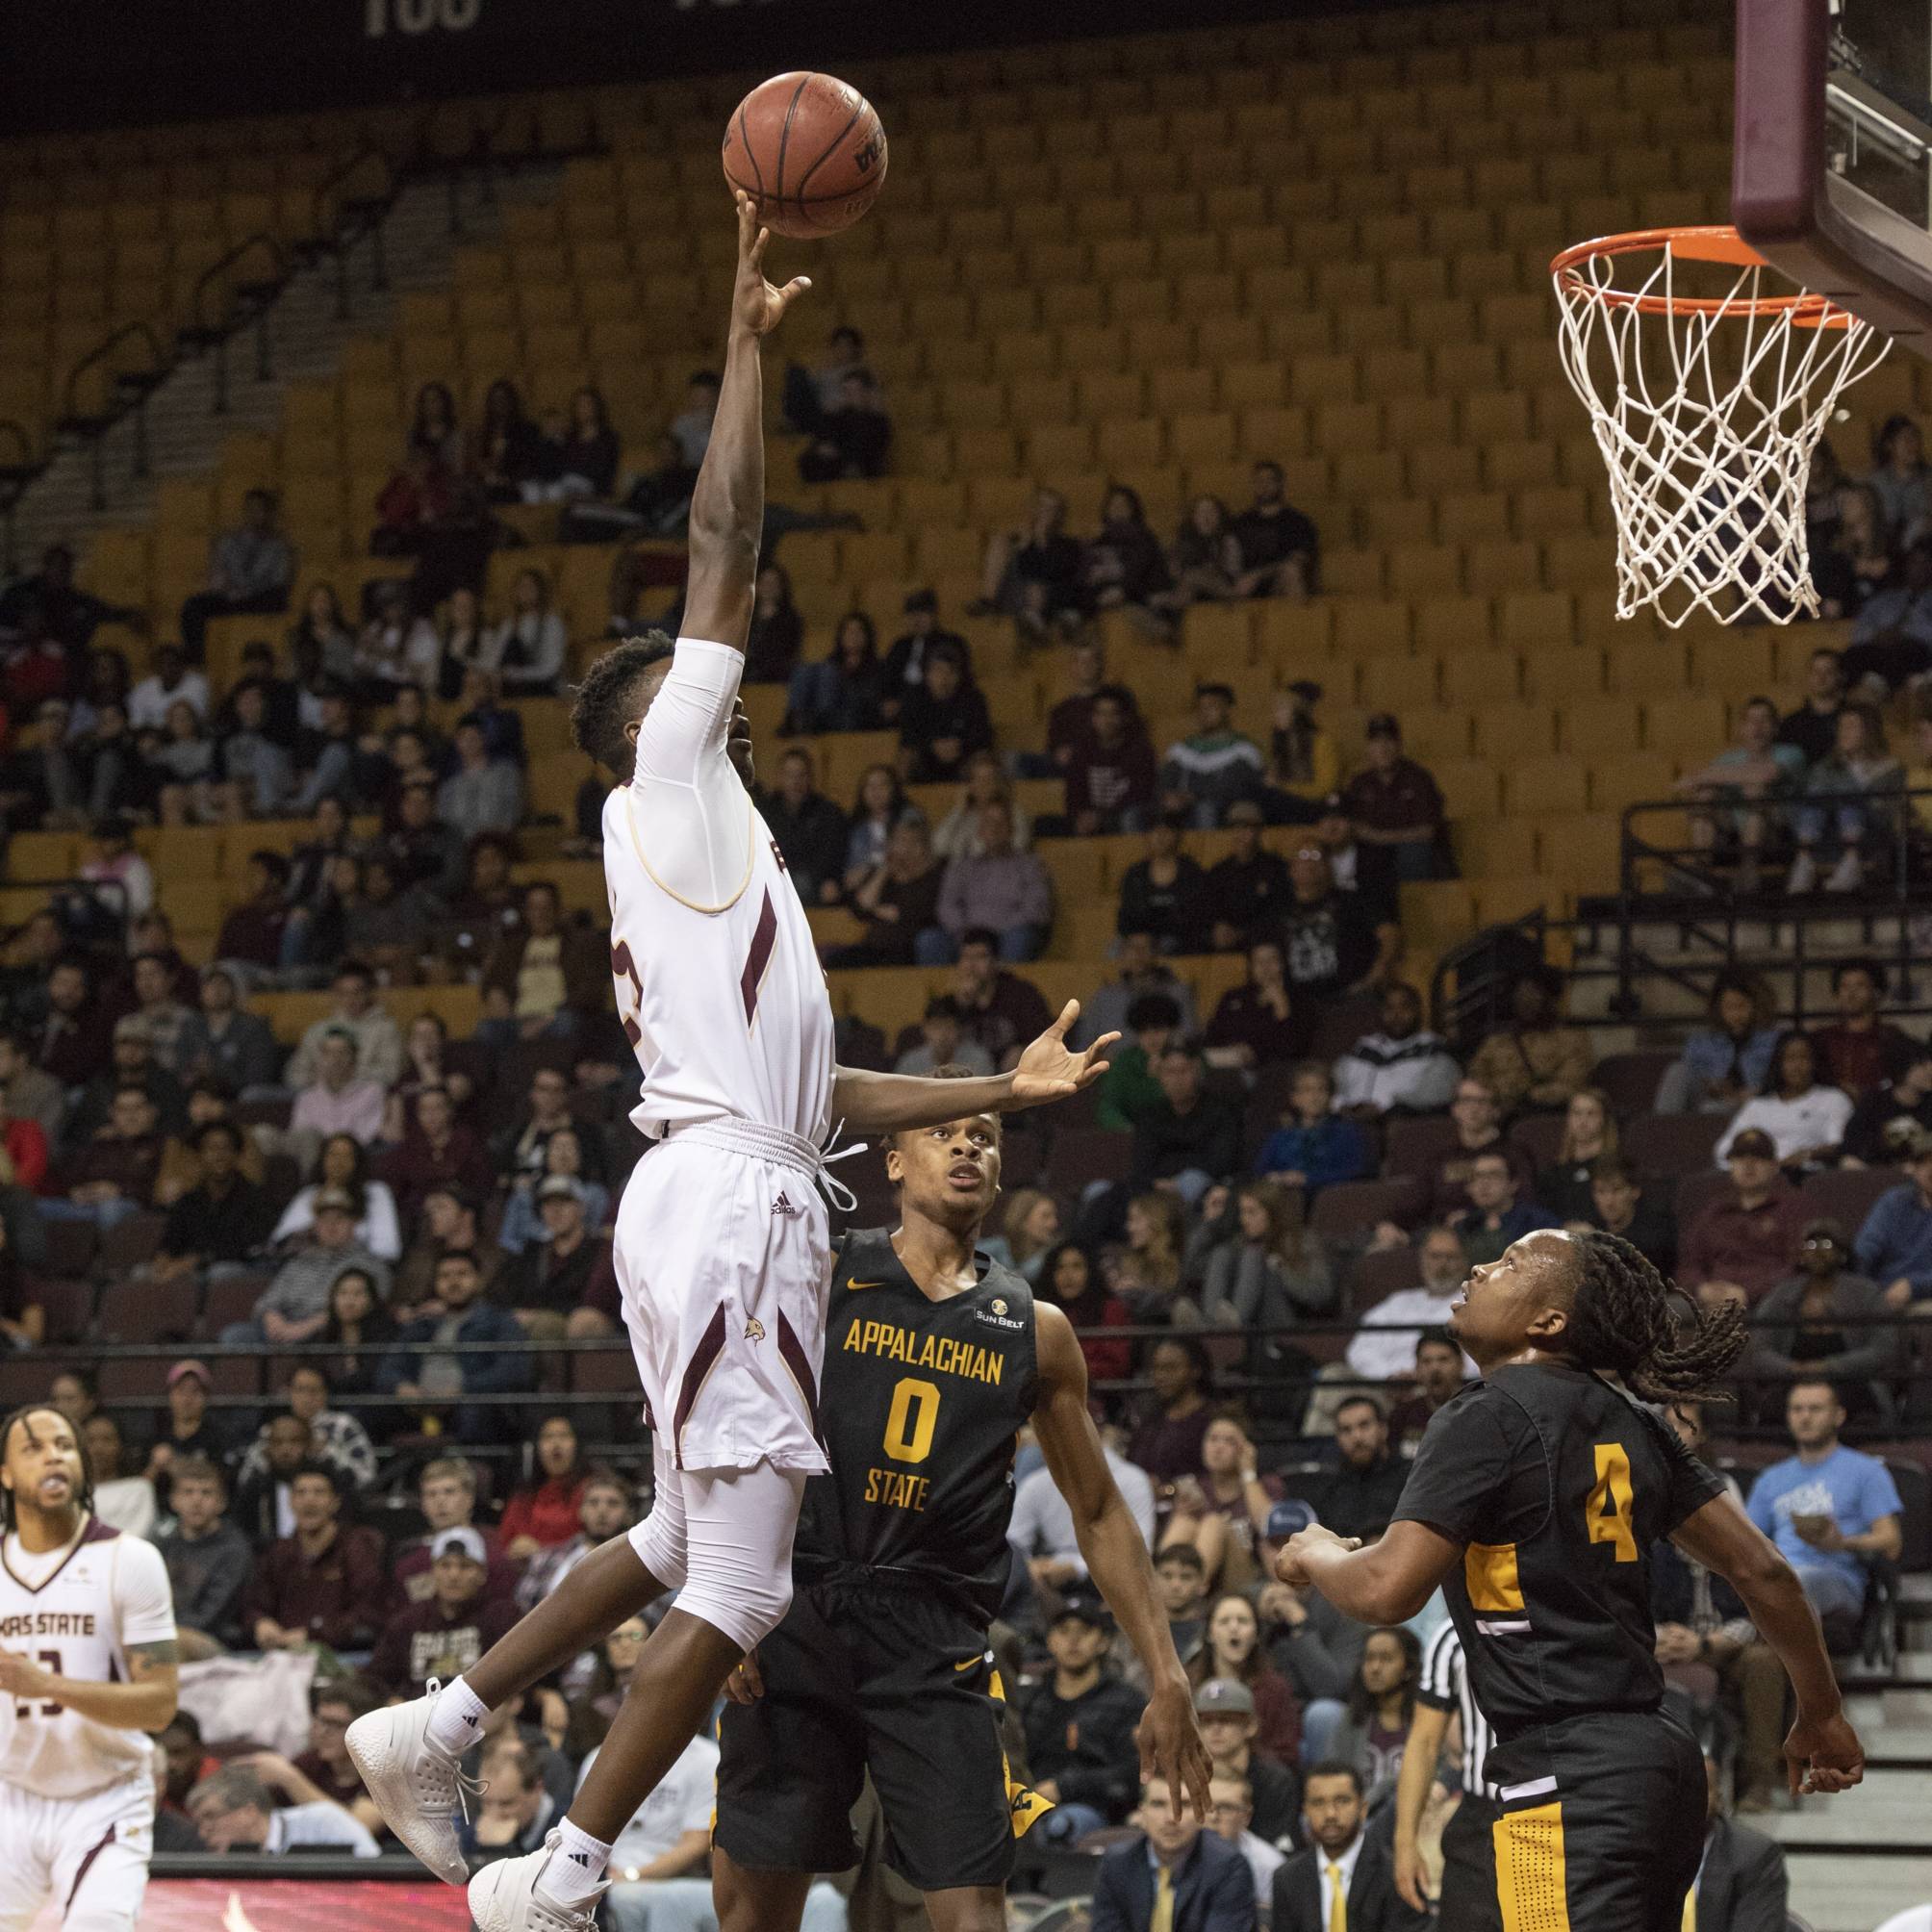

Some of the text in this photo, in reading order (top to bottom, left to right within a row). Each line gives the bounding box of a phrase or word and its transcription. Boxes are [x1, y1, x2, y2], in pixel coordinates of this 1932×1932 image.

[843, 1318, 1004, 1385] APPALACHIAN
[883, 1377, 941, 1463] 0
[864, 1468, 930, 1512] STATE
[1586, 1442, 1639, 1563] 4
[37, 1613, 94, 1636] STATE
